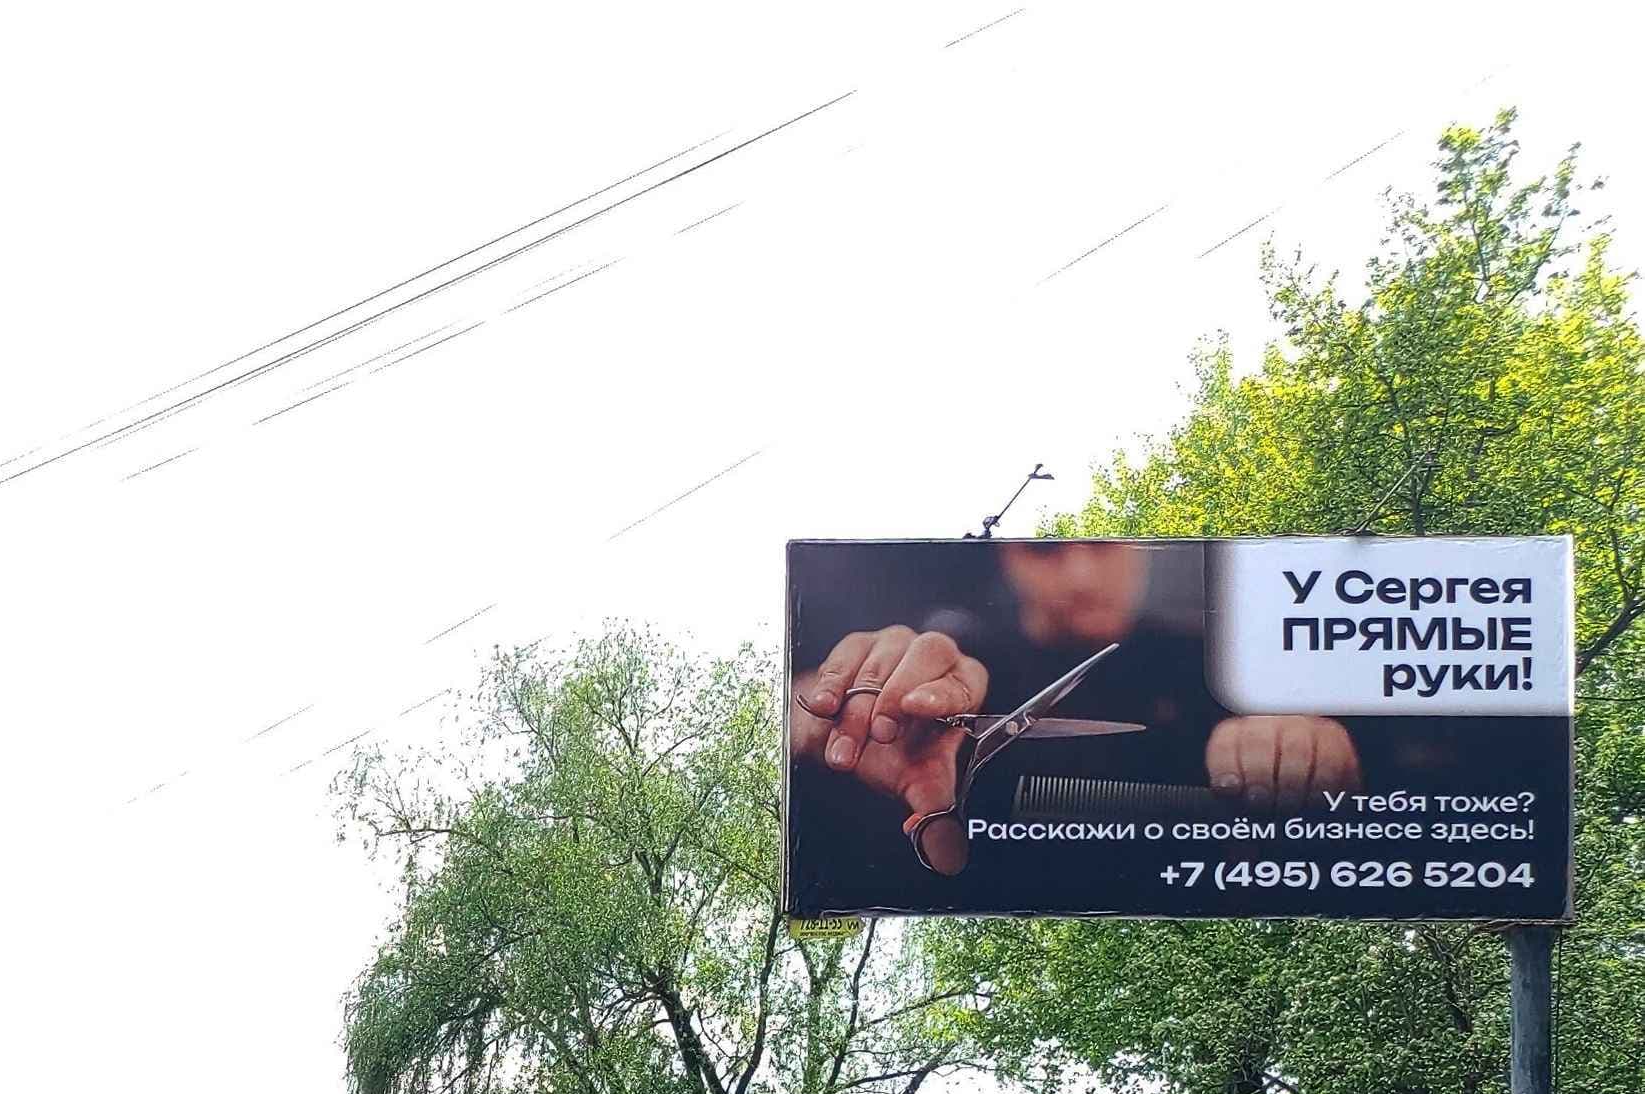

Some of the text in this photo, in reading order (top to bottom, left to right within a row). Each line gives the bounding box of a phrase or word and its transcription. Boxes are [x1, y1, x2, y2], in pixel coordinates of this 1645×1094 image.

[1282, 569, 1532, 610] У Сергея
[1282, 617, 1532, 651] ПРЯМЫЕ
[1383, 656, 1533, 697] руки!
[1323, 790, 1535, 813] У тебя тоже?
[968, 817, 1535, 843] Расскажи о своём бизнесе здесь!
[1160, 861, 1535, 891] +7 (495) 626 5204
